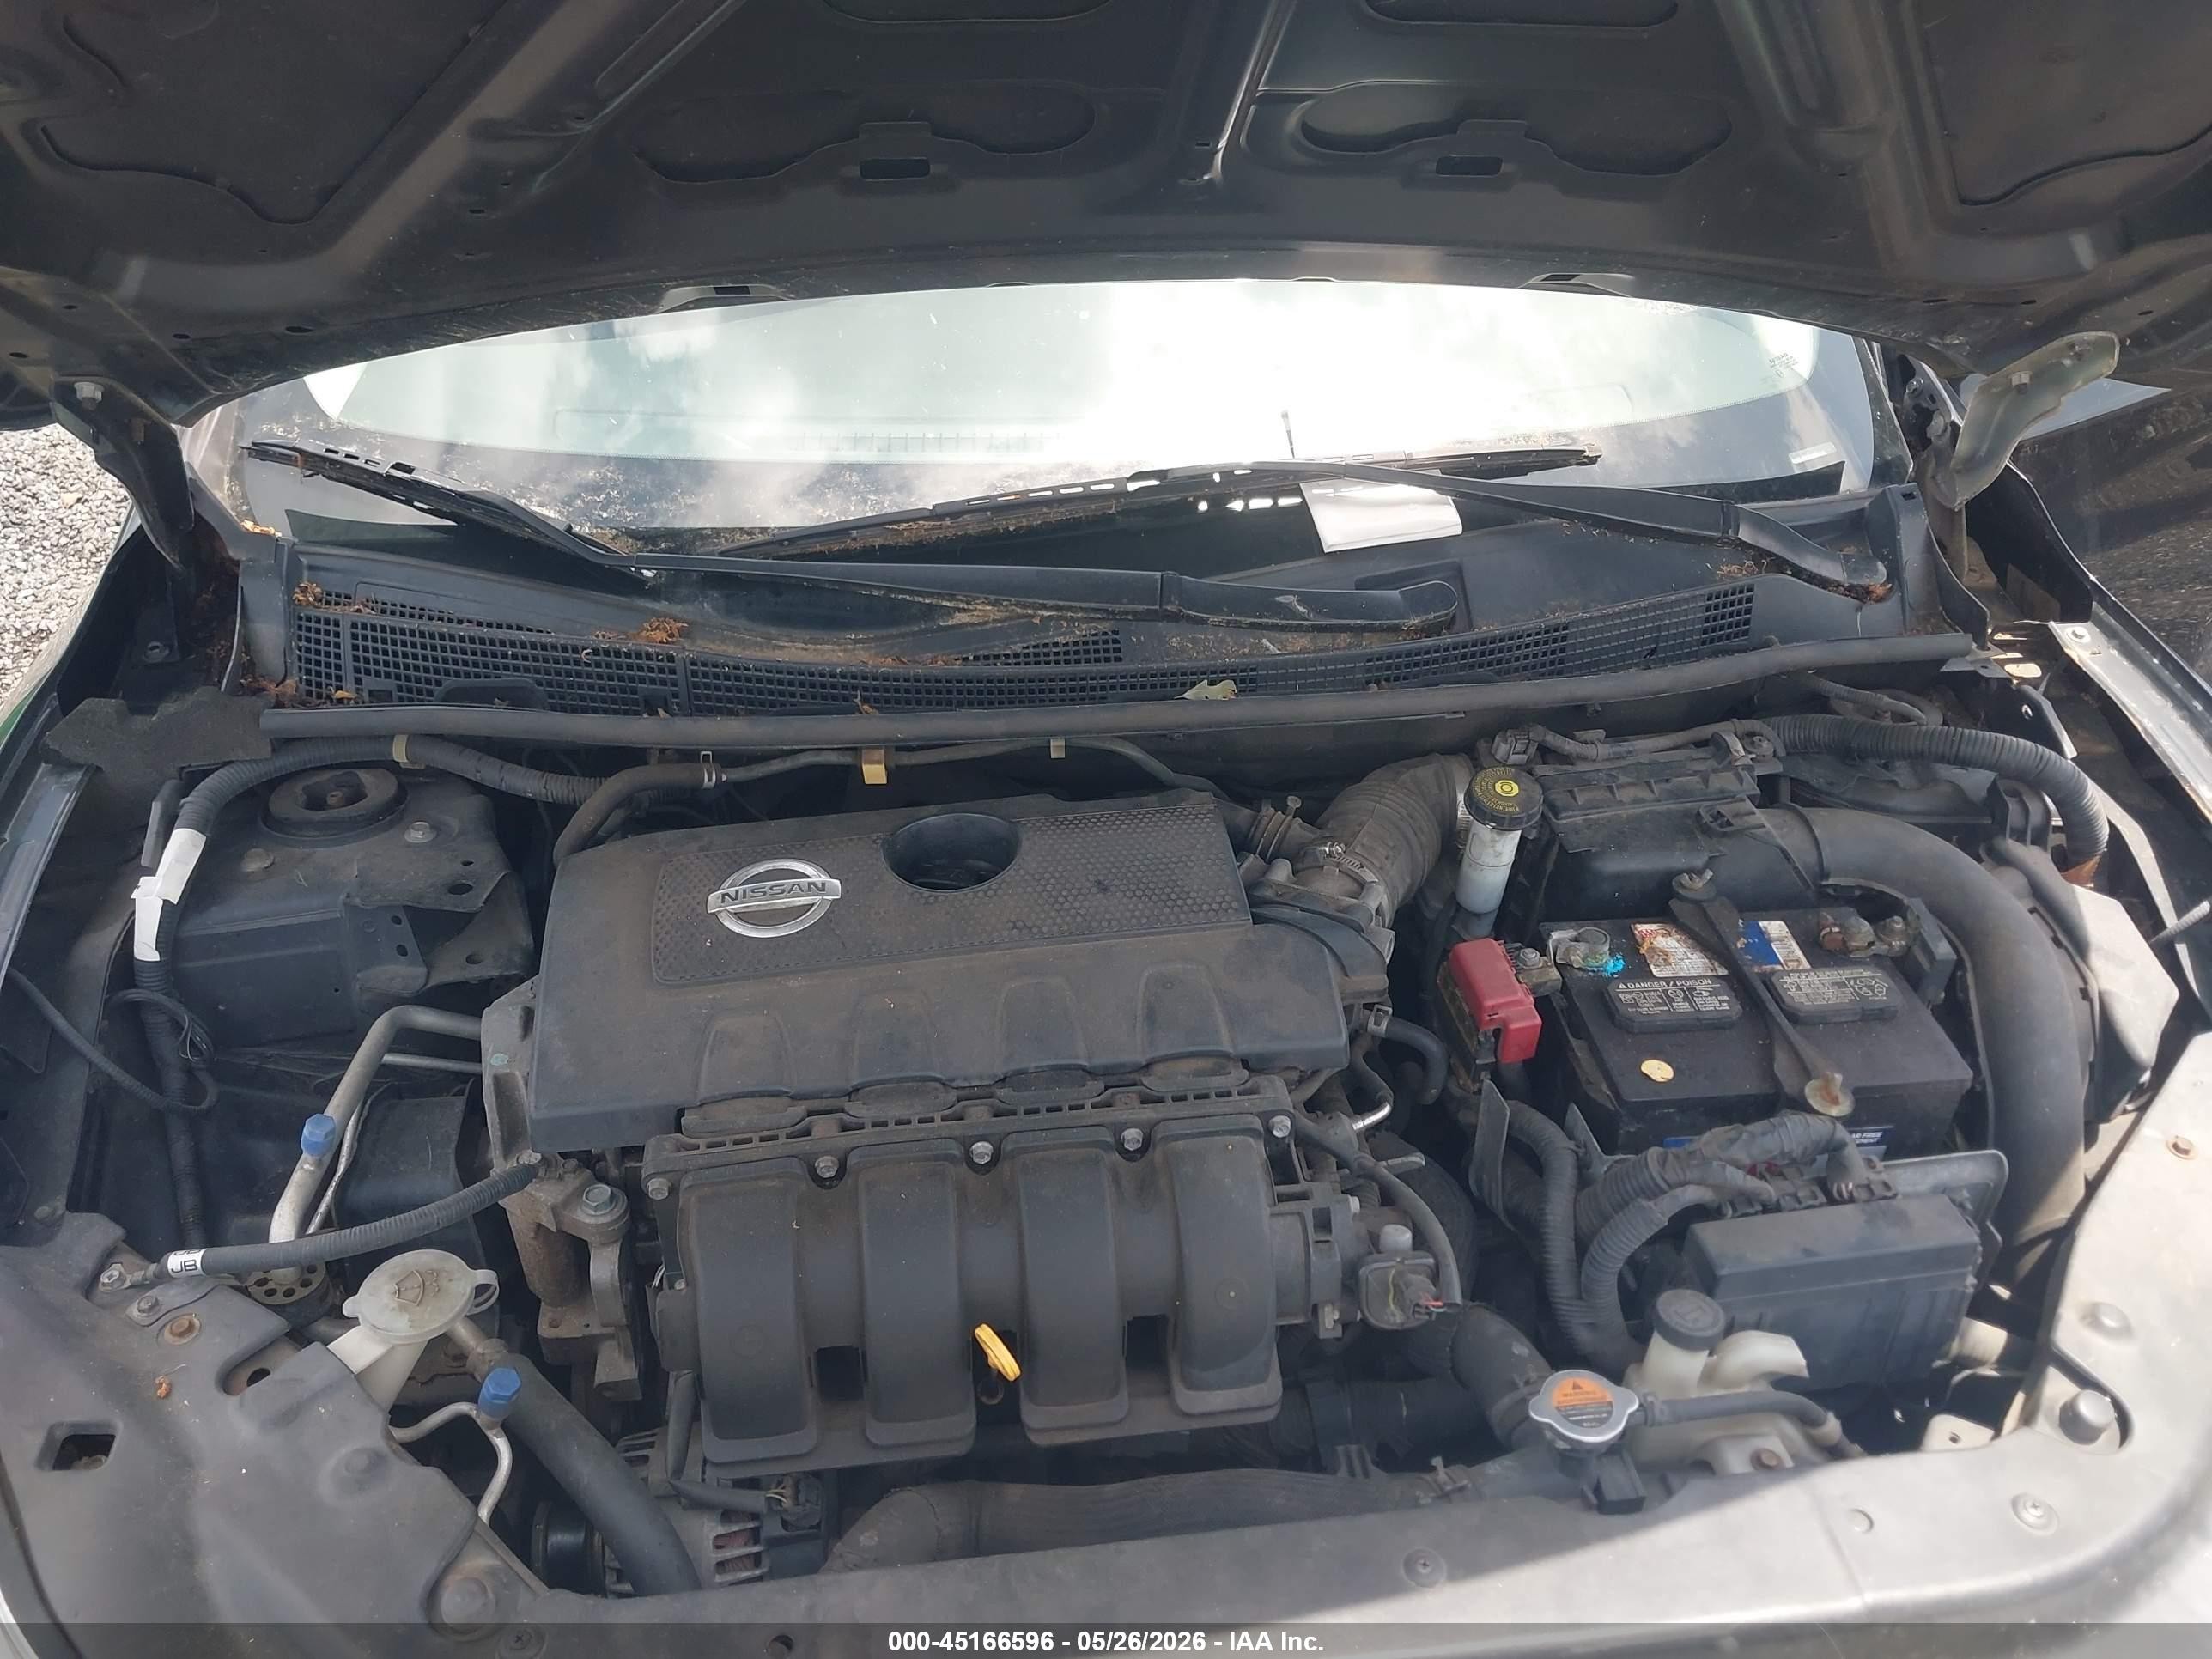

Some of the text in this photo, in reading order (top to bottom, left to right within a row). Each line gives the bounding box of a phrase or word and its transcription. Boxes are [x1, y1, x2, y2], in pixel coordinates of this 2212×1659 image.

[720, 881, 826, 904] NISSAN
[1626, 980, 1668, 989] DANGER
[1676, 978, 1712, 987] POISON
[171, 1259, 198, 1273] JB
